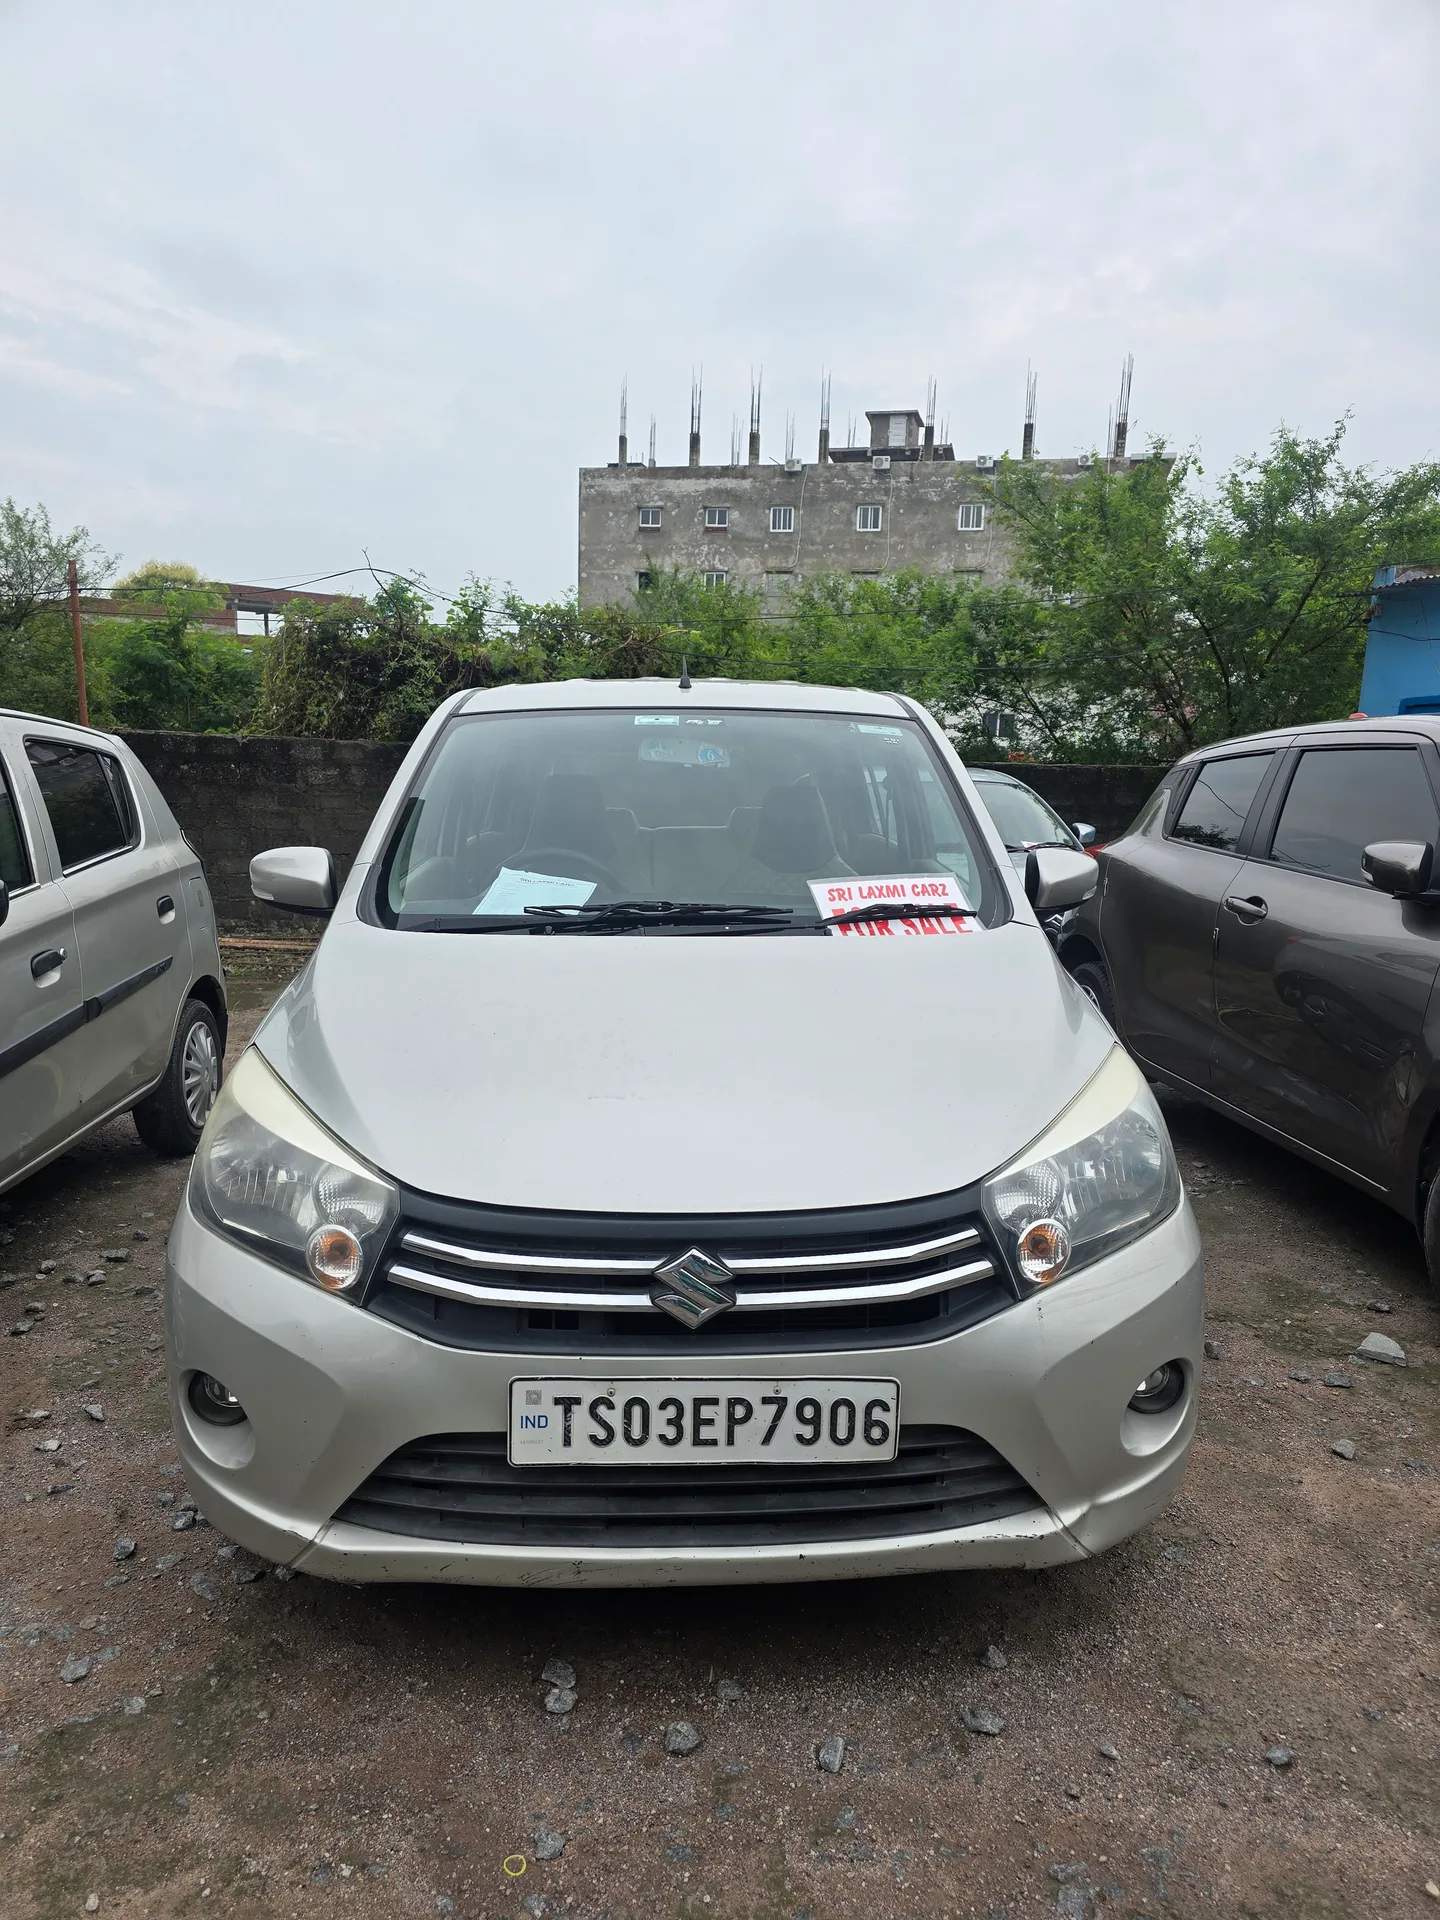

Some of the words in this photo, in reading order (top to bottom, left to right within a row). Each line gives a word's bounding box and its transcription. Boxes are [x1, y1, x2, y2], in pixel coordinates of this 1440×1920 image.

[827, 887, 853, 902] SRI
[858, 884, 907, 900] LAXMI
[911, 883, 949, 897] CARZ
[520, 1415, 549, 1429] IND
[553, 1395, 891, 1447] TS03EP7906
